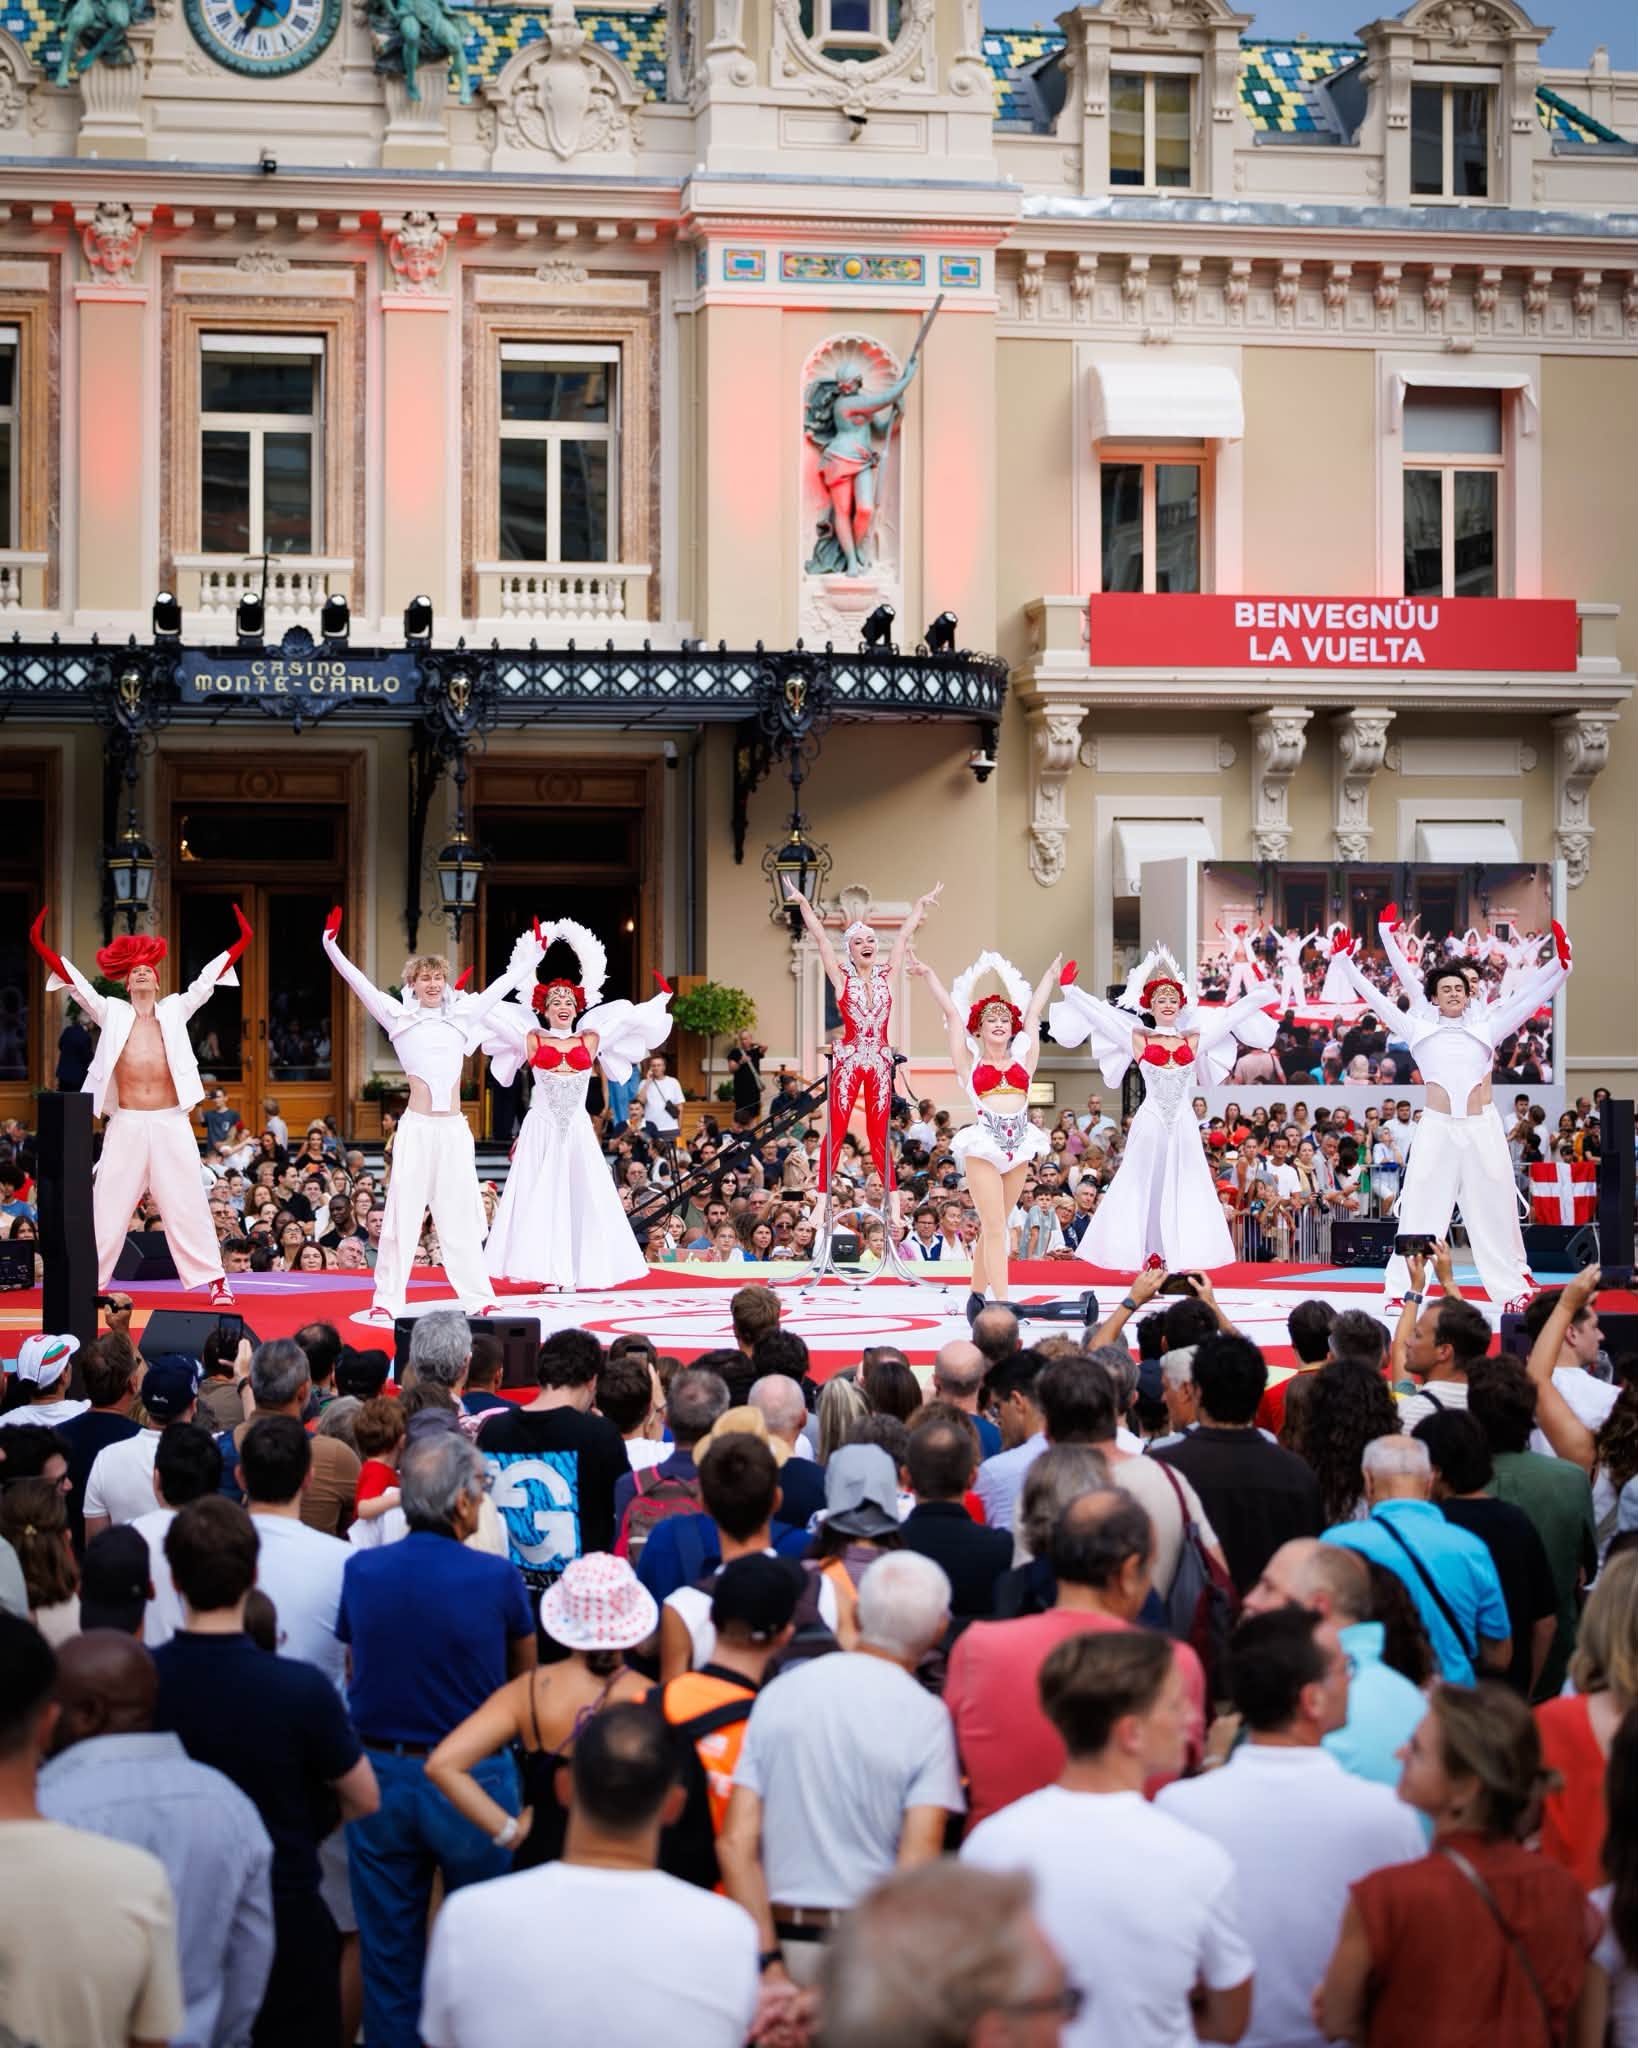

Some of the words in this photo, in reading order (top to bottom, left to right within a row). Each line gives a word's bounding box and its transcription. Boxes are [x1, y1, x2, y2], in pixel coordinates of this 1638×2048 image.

[1234, 599, 1439, 630] BENVEGNÜU
[1249, 635, 1292, 661] LA
[1301, 636, 1426, 663] VUELTA
[251, 661, 346, 677] CASINO
[194, 674, 401, 693] MONTE-CARLO
